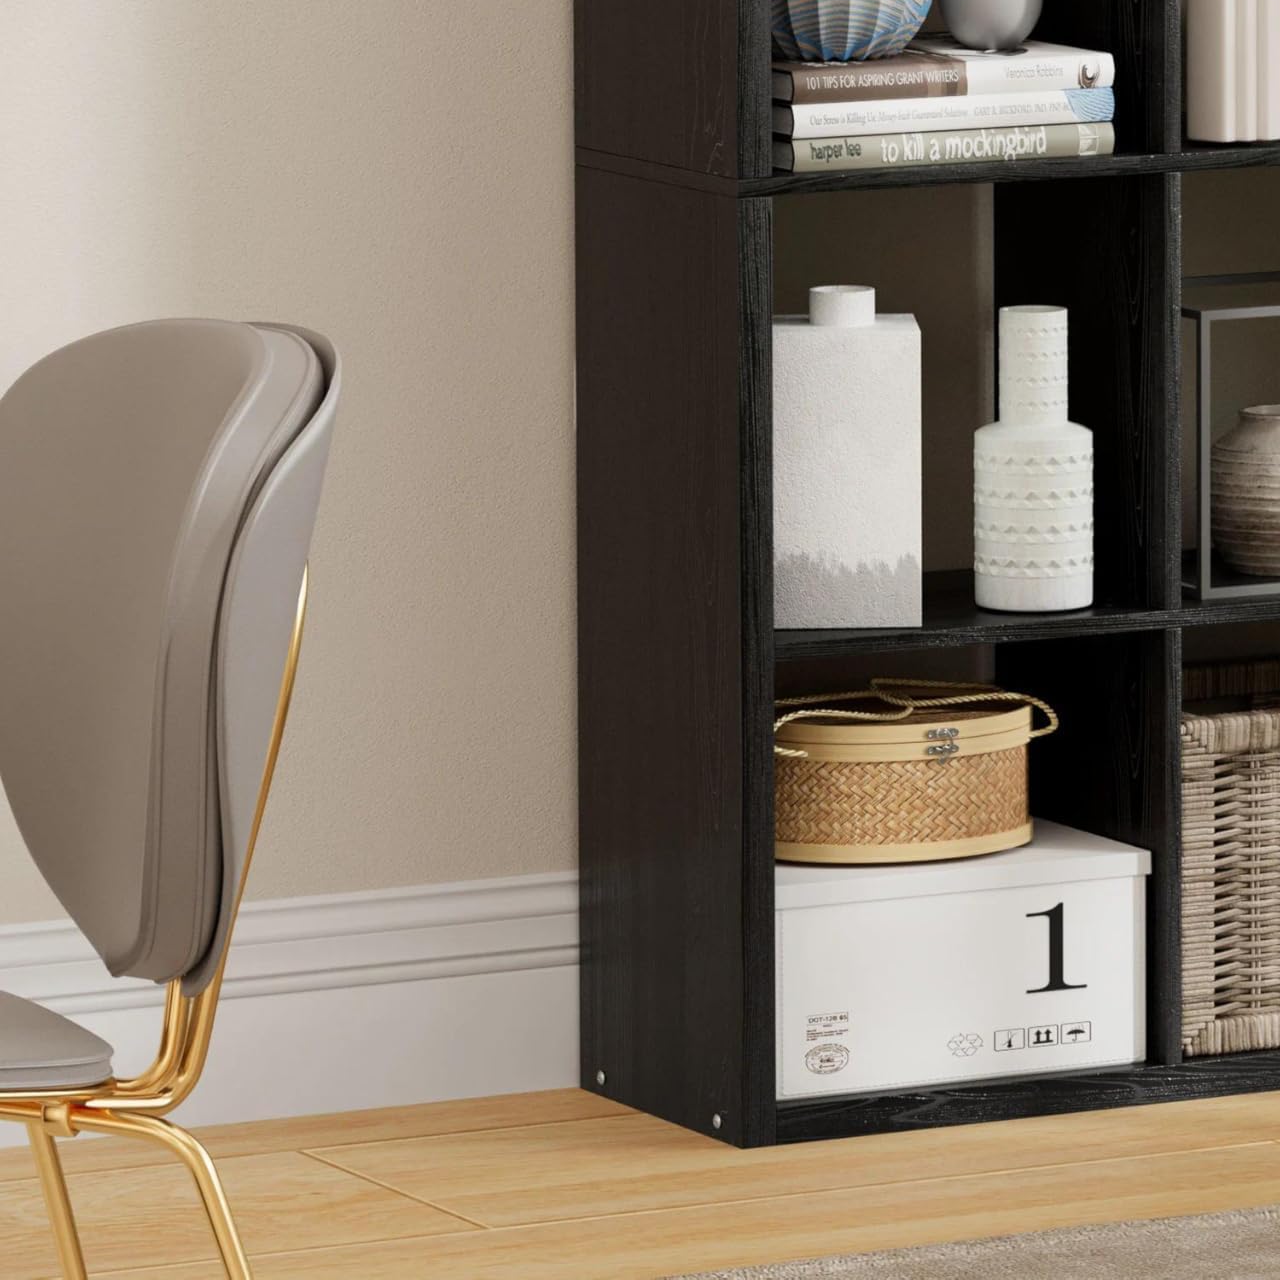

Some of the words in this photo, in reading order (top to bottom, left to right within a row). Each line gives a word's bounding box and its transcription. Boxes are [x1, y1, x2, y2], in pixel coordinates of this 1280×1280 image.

[806, 77, 821, 90] 101
[822, 76, 839, 89] TIPS
[839, 75, 856, 89] FOR
[857, 74, 894, 87] ASPIRING
[896, 71, 925, 85] GRANT
[925, 70, 959, 83] WRITERS
[809, 141, 843, 163] harper
[844, 138, 862, 157] lee
[880, 138, 898, 163] to
[902, 131, 924, 161] kill
[929, 137, 941, 161] a
[944, 126, 1047, 161] mockingbird
[1025, 901, 1088, 994] 1
